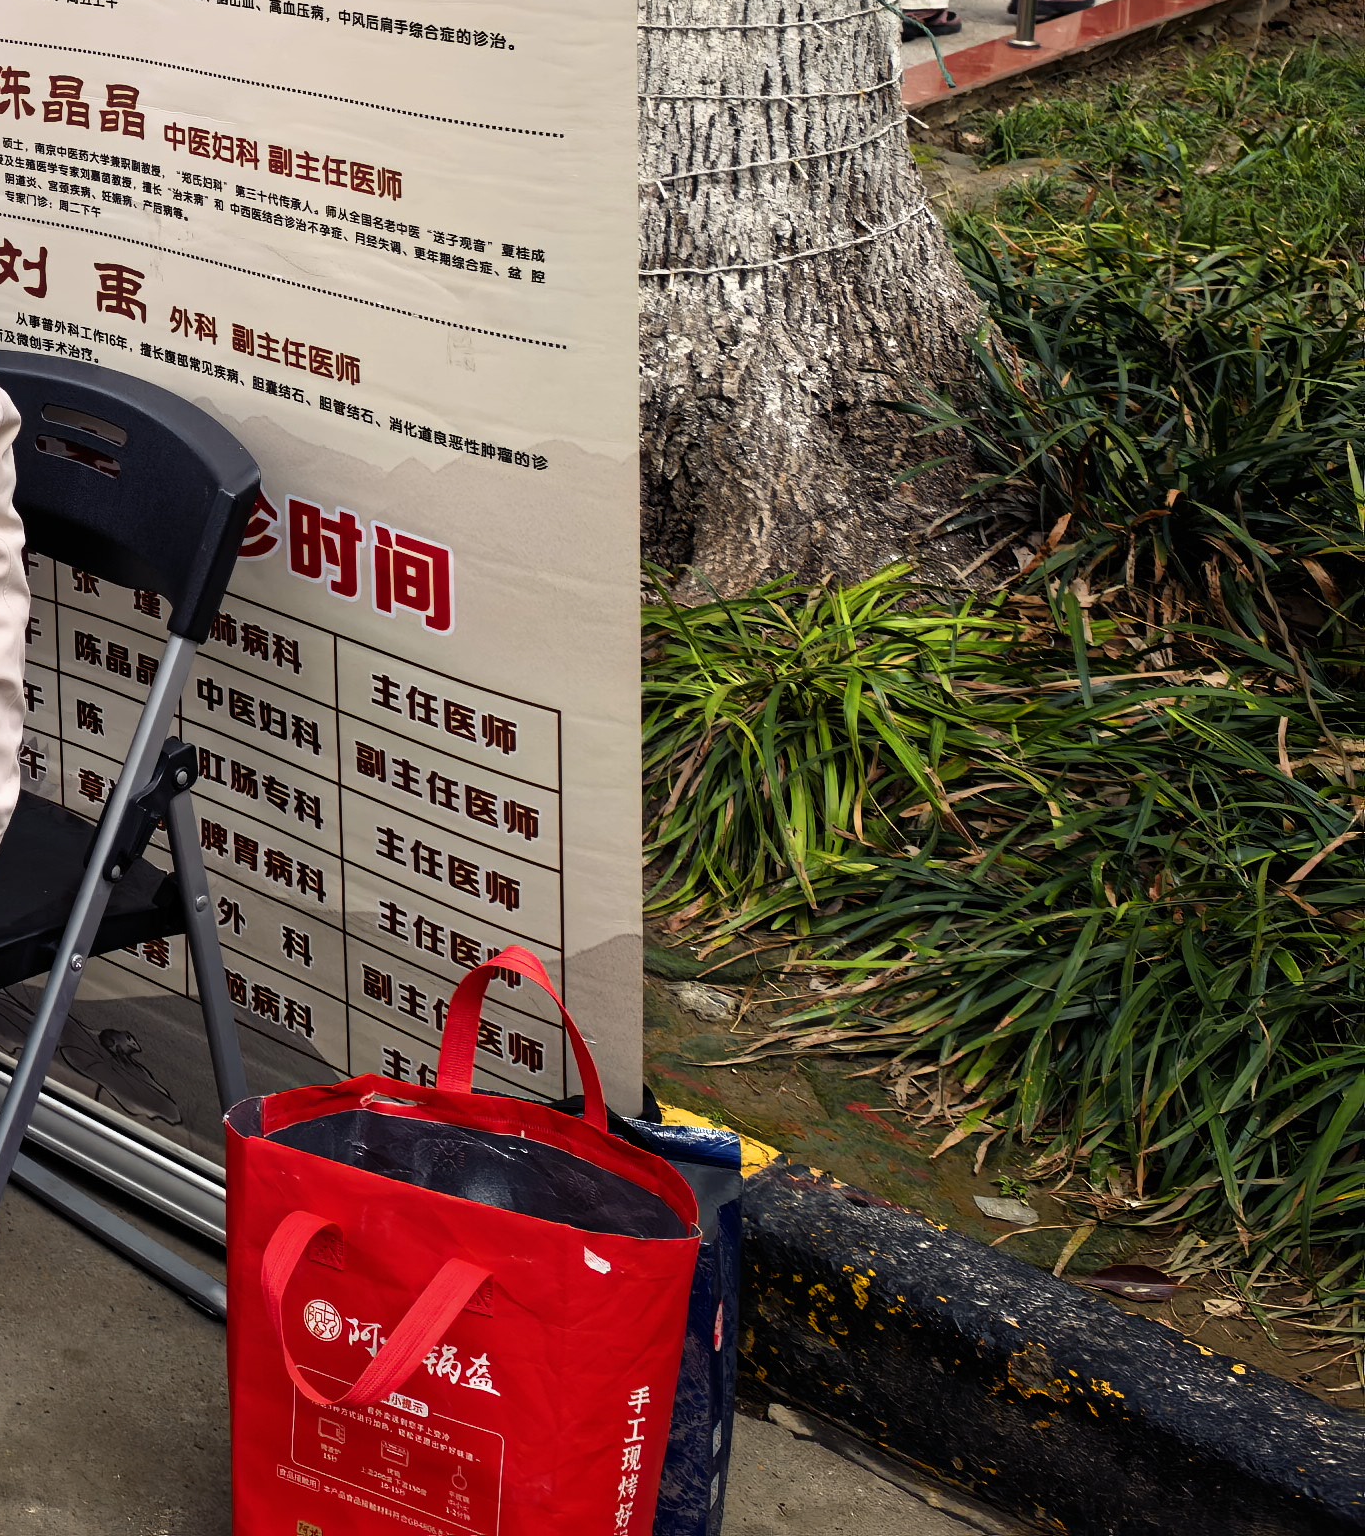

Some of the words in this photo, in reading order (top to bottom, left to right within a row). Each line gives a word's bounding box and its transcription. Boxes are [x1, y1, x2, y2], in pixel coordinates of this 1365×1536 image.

[164, 122, 261, 171] 中医妇科
[268, 144, 403, 202] 副主任医师
[170, 304, 218, 345] 外科
[231, 321, 362, 387] 副主任医师
[371, 673, 518, 756] 主任医师
[195, 676, 323, 756] 中医妇科
[355, 740, 541, 840] 副主任医师
[76, 698, 105, 737] 陈
[197, 746, 324, 829] 肛肠专科
[376, 825, 521, 912] 主任医师
[78, 768, 117, 804] 章
[200, 818, 327, 902] 脾胃病科
[345, 1316, 501, 1396] 阿锅盔
[382, 1391, 426, 1414] 小提示
[614, 1385, 651, 1536] 手工现烤好
